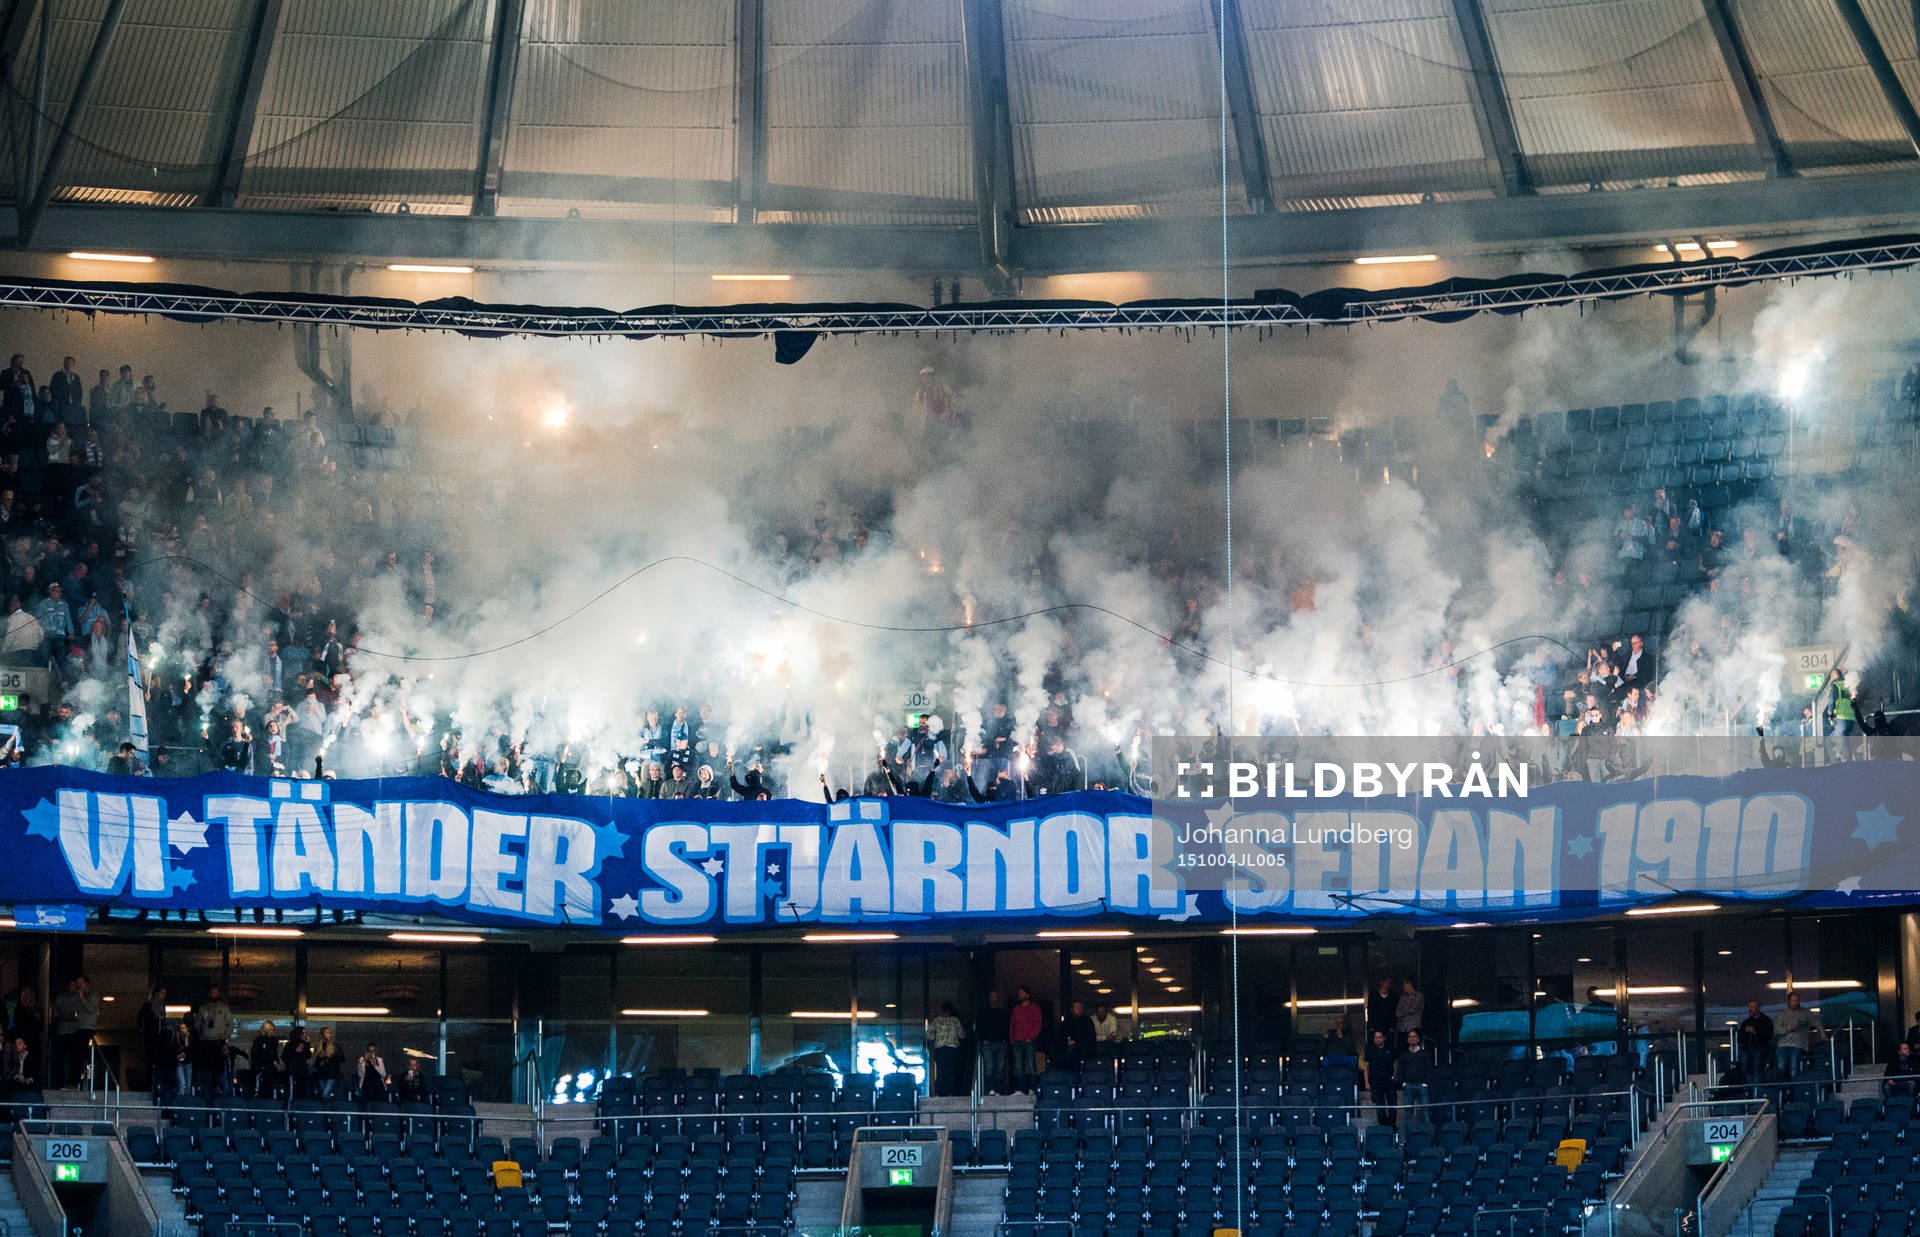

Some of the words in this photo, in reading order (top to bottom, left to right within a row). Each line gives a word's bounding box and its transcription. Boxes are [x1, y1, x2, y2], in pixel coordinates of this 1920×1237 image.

[1801, 653, 1828, 669] 304
[56, 788, 171, 898] VI
[204, 778, 602, 925] TÄNDER
[638, 798, 1185, 924] STJÄRNOR
[1223, 805, 1562, 915] SEDAN
[1597, 792, 1814, 907] 1910
[1709, 1124, 1738, 1139] 204
[52, 1143, 82, 1158] 206
[887, 1149, 917, 1163] 205
